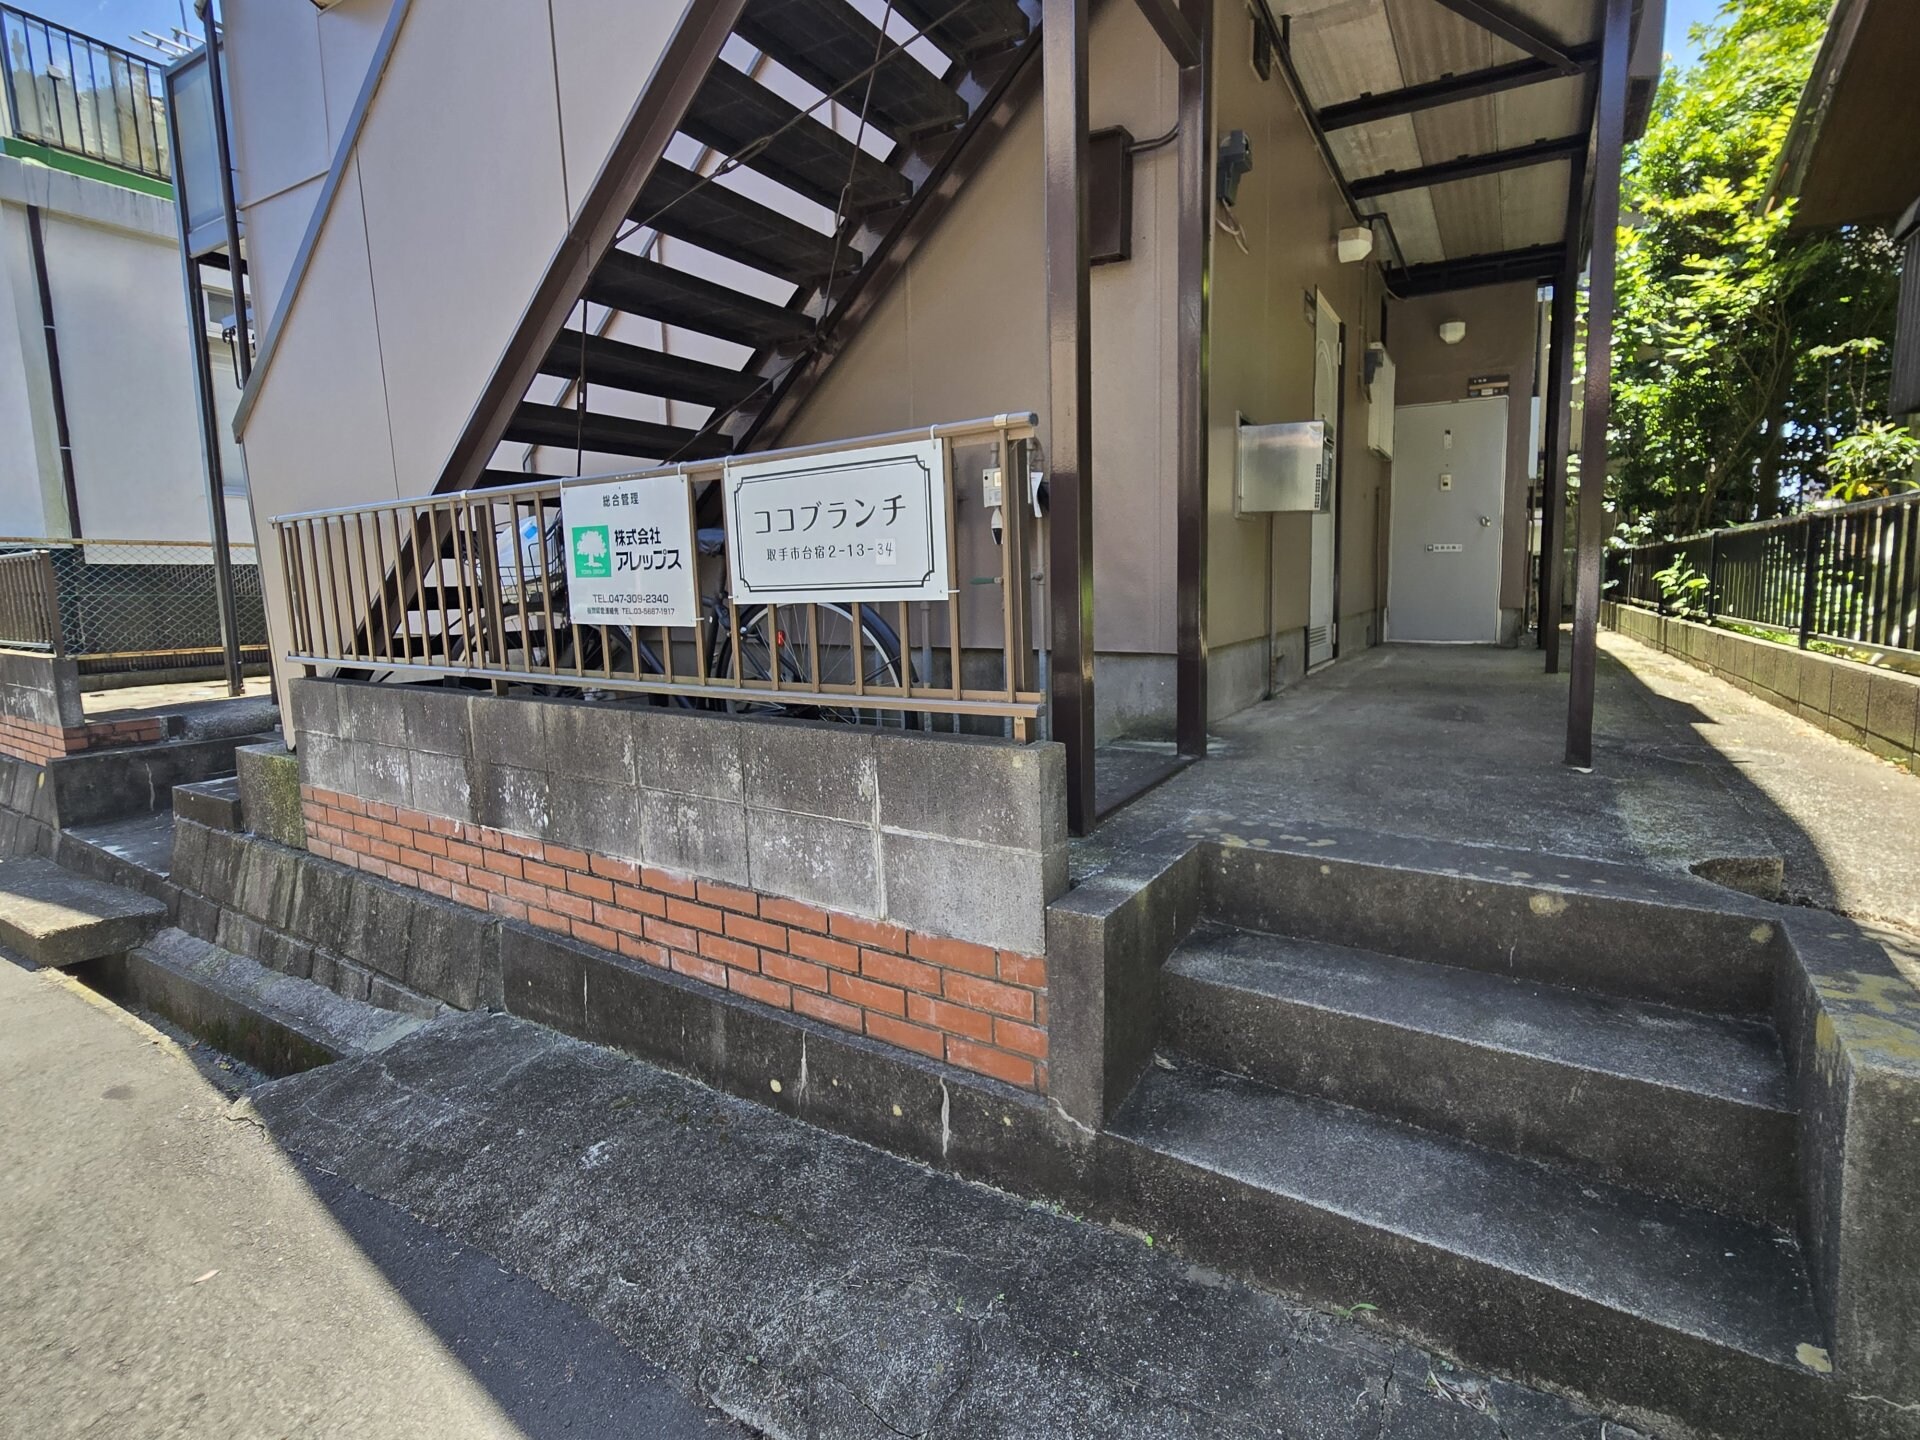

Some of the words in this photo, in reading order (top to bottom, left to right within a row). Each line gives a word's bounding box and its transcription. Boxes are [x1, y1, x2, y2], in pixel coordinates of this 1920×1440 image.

[603, 492, 640, 507] 総合管理
[754, 494, 906, 534] ココブランチ
[614, 527, 662, 547] 株式会社
[616, 549, 683, 571] アレップス
[592, 593, 669, 604] TEL.047-309-2340
